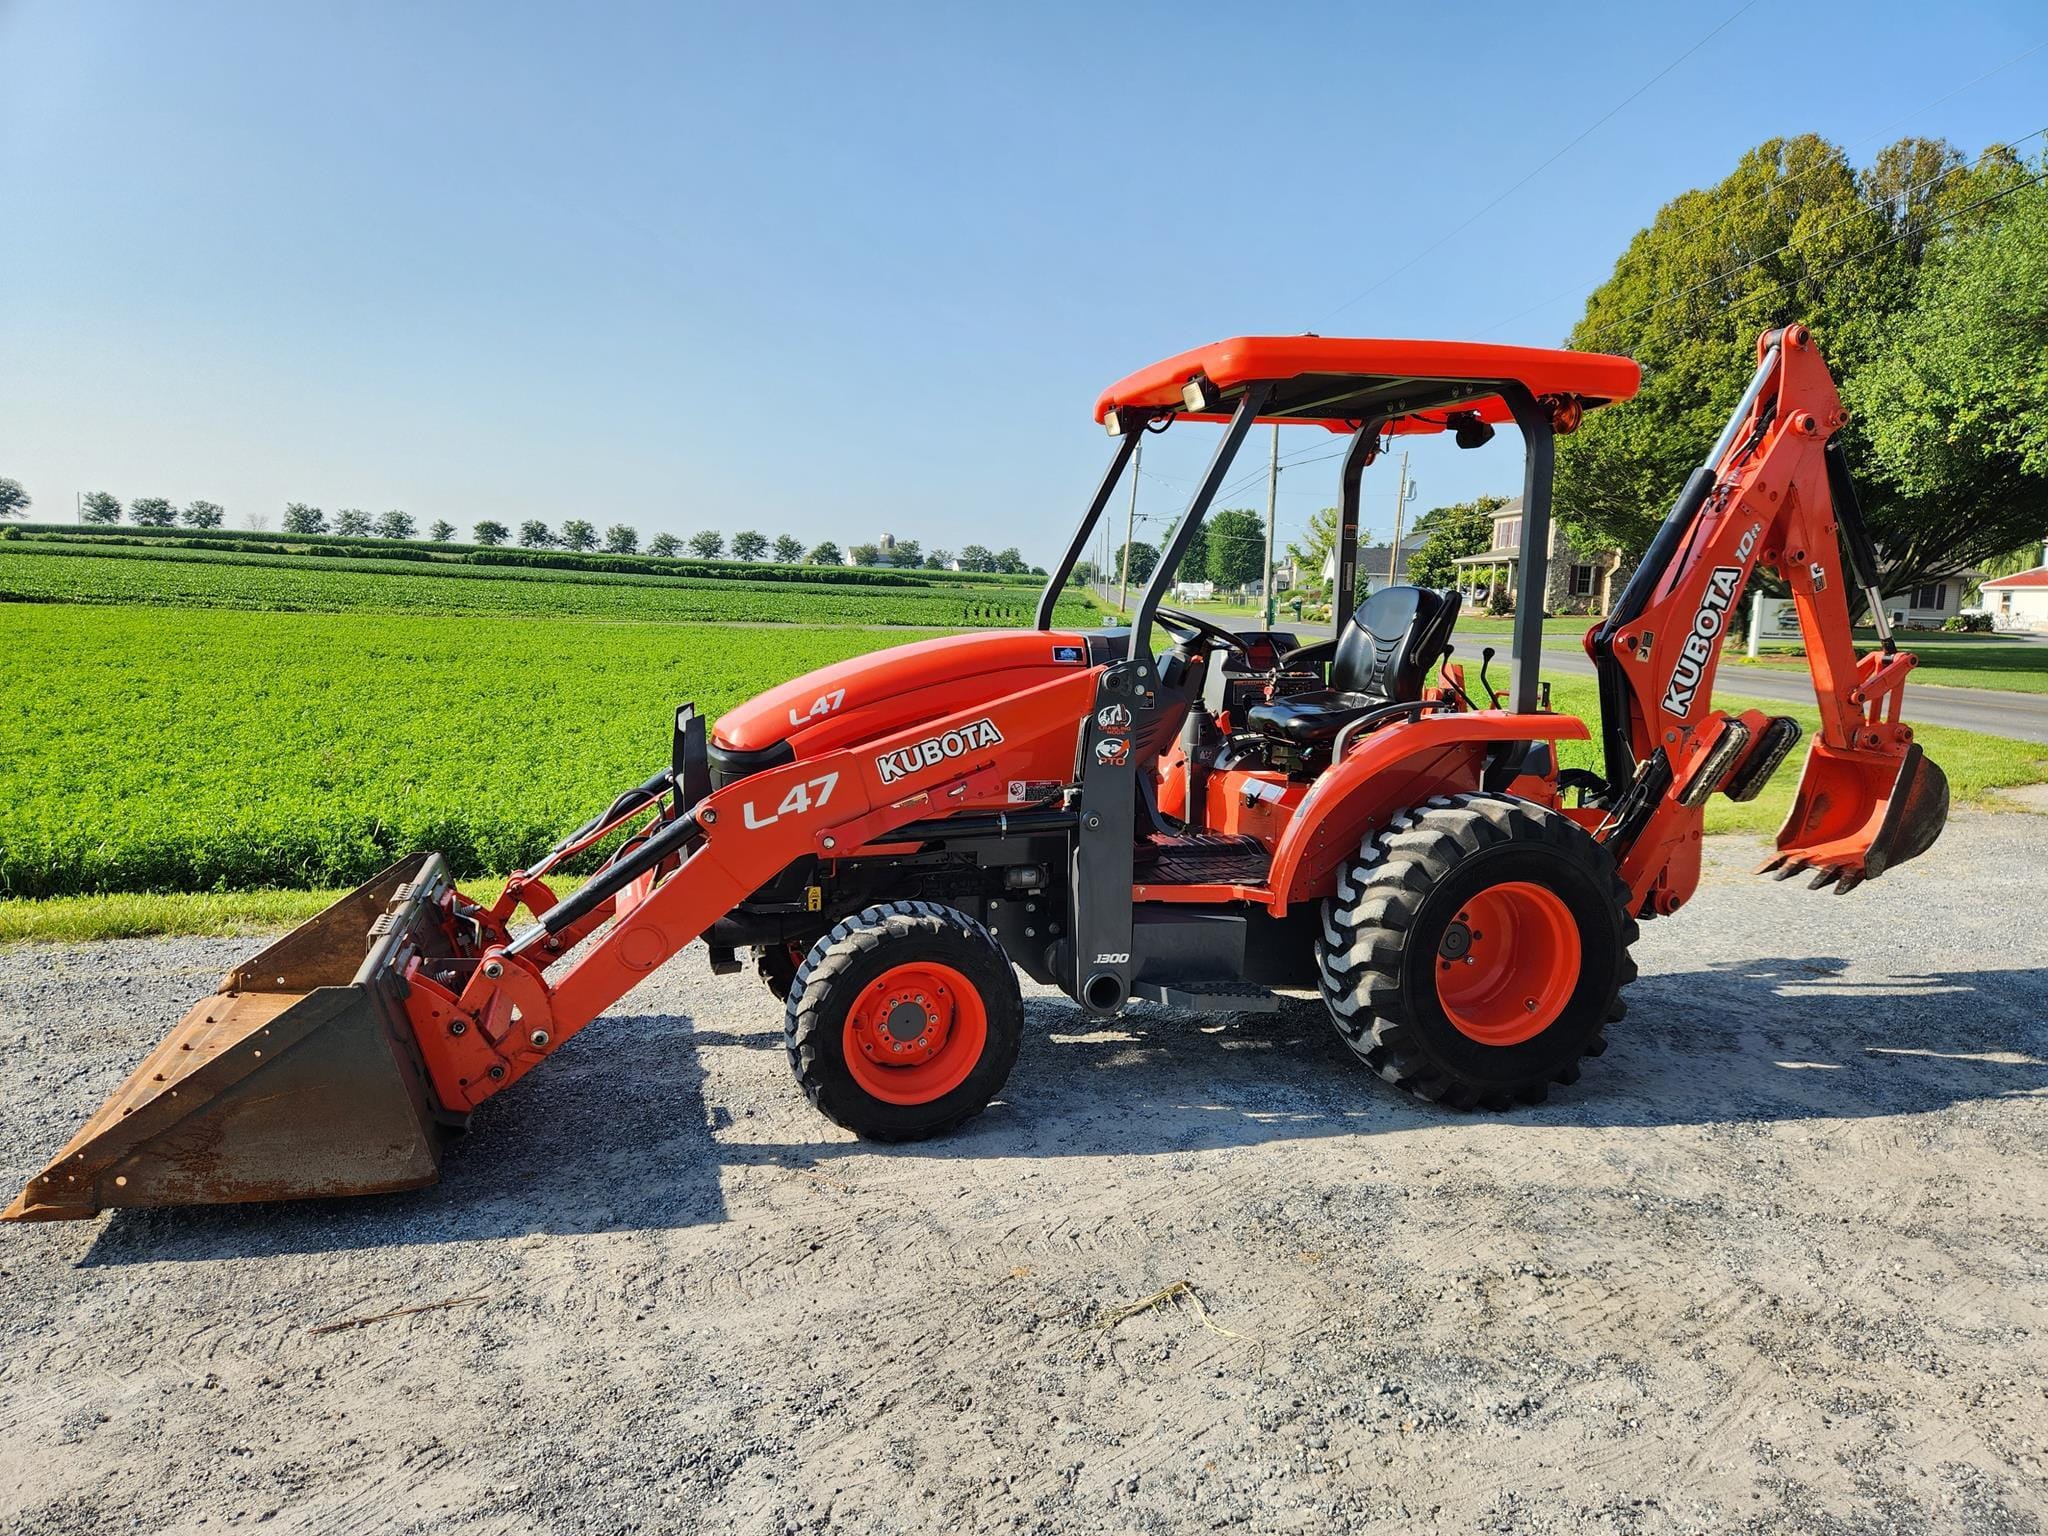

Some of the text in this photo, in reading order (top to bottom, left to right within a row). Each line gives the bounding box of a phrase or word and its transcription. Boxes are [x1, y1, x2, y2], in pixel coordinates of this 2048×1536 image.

[1661, 566, 1743, 719] KUBOTA
[789, 688, 846, 726] L47
[877, 719, 1003, 784] KUBOTA
[1098, 757, 1126, 766] PTO
[743, 771, 839, 829] L47
